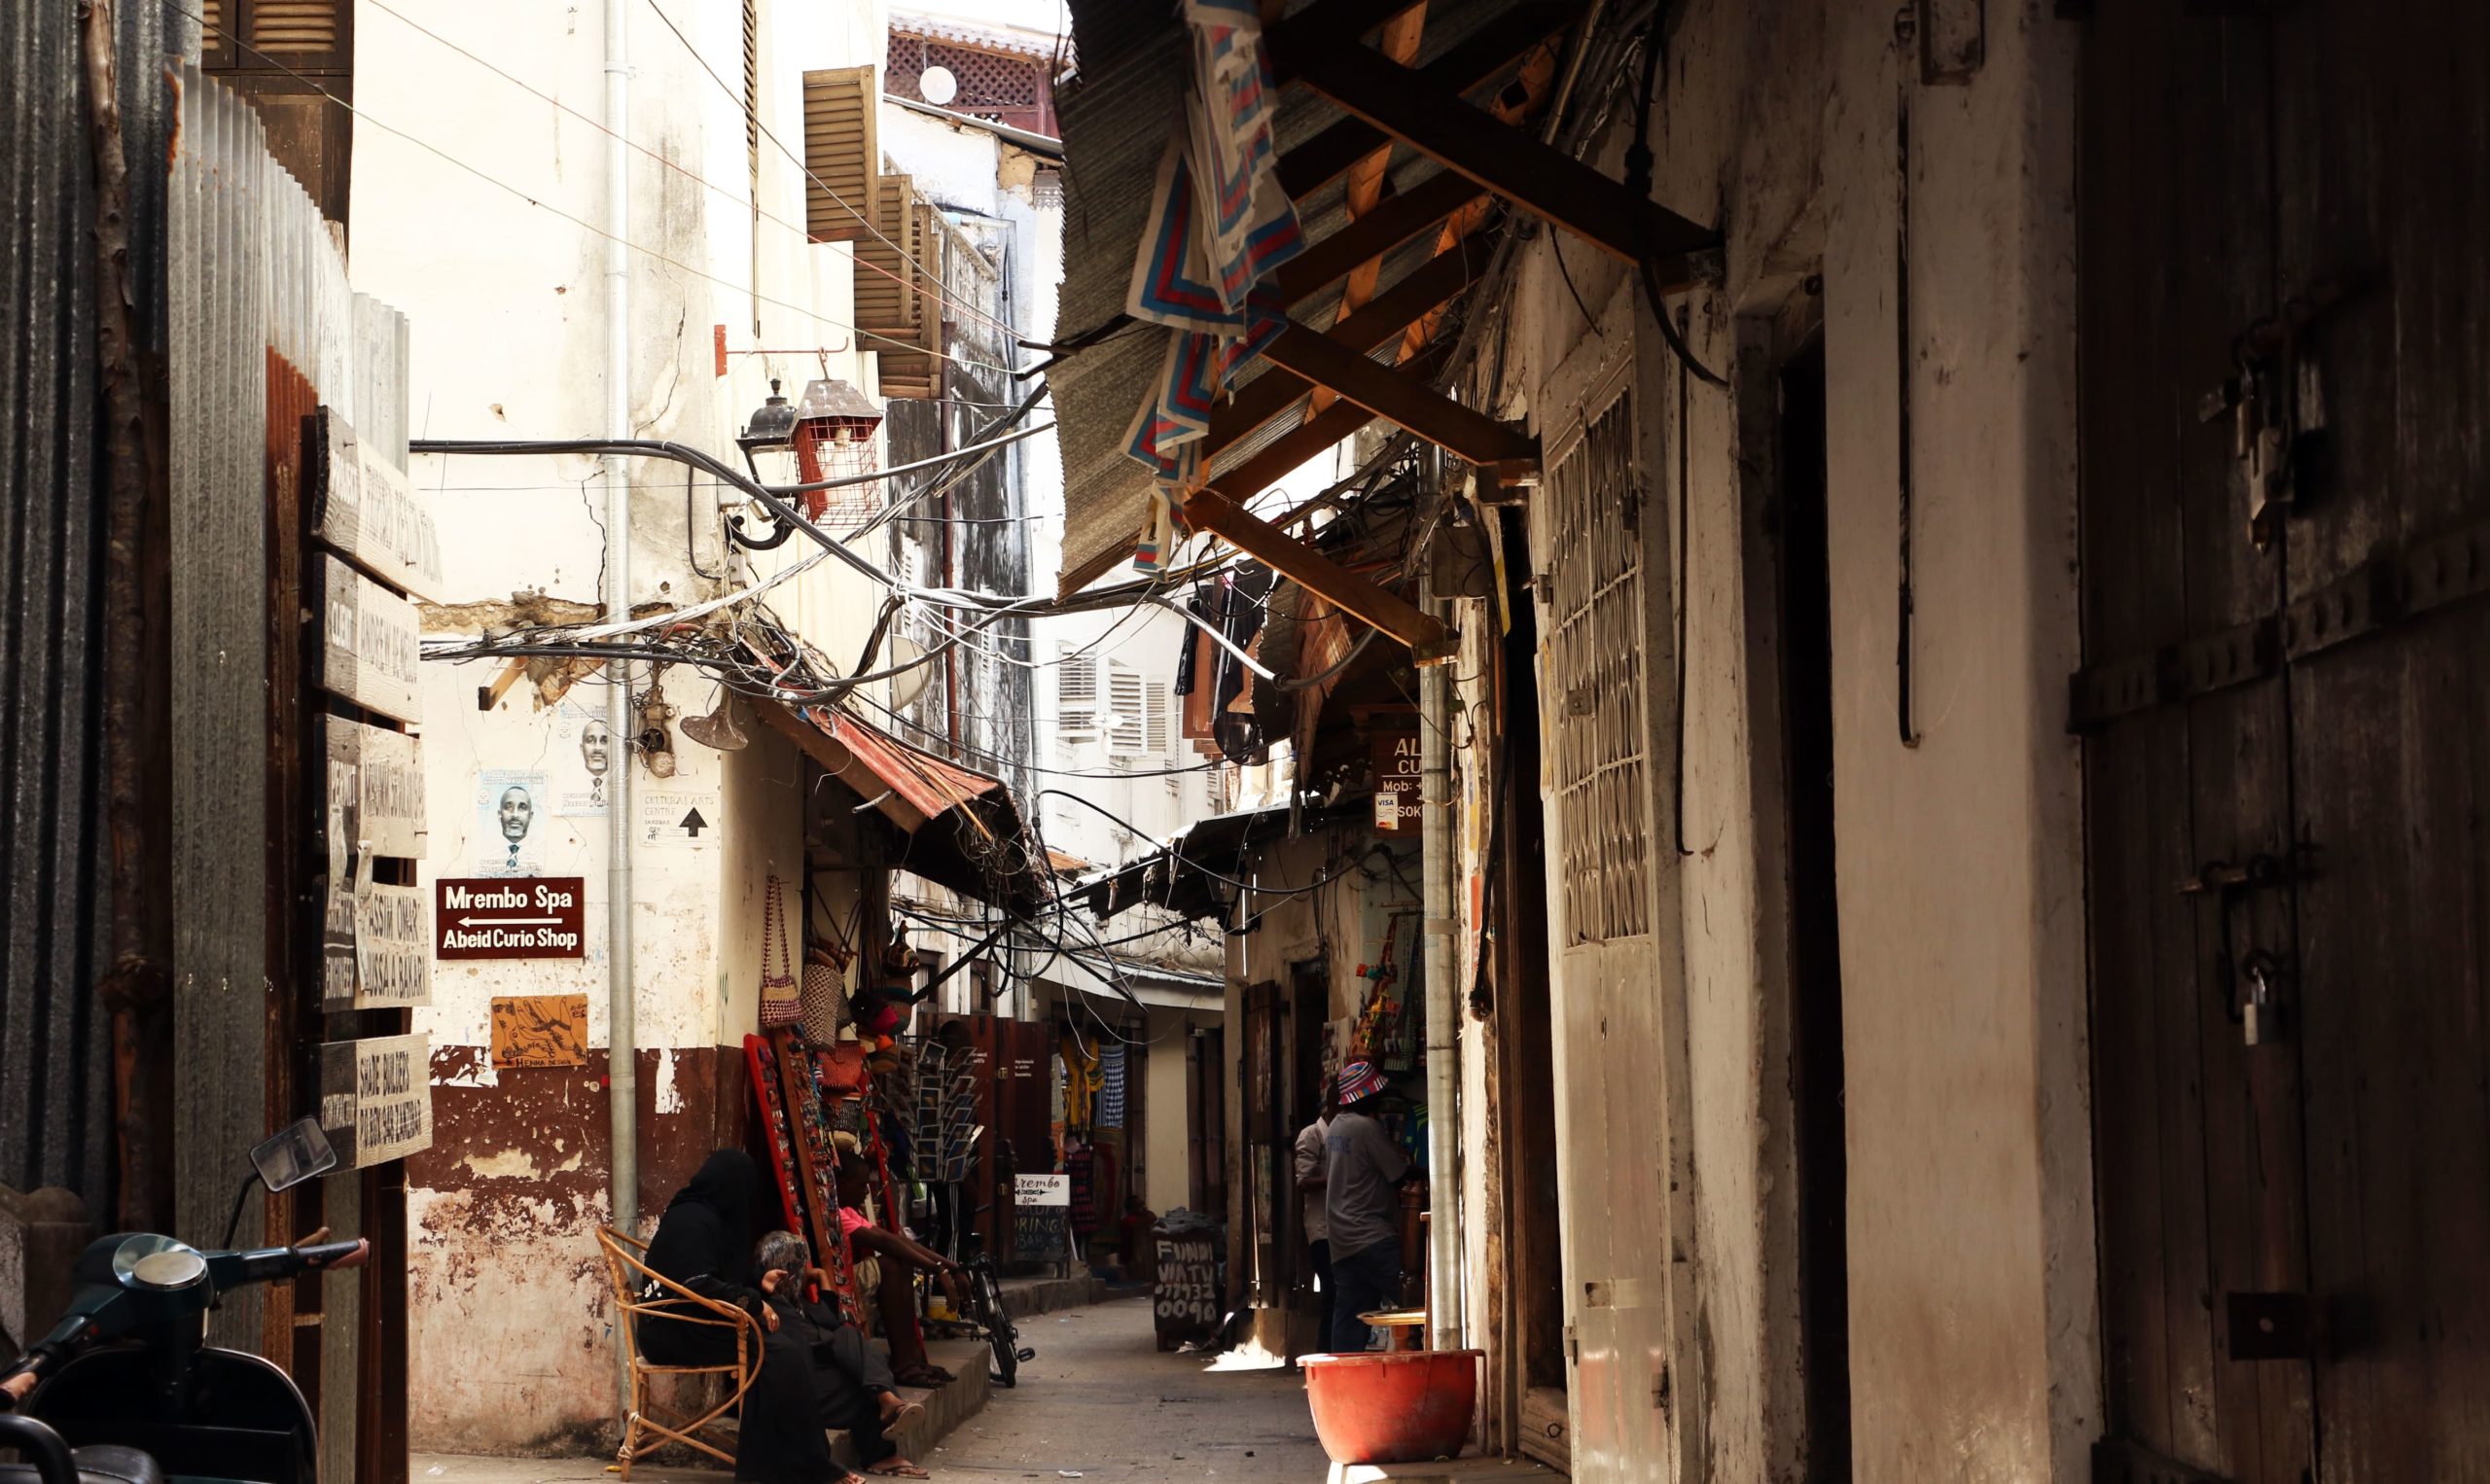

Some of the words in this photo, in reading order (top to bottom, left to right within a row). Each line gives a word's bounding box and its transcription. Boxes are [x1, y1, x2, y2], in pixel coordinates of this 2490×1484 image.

[645, 795, 689, 806] CULTURAL
[691, 795, 715, 806] ARTS
[645, 807, 677, 816] CENTRE
[445, 886, 528, 909] Mrembo
[535, 885, 573, 915] Spa
[443, 930, 492, 949] Abeid
[493, 929, 534, 948] Curio
[537, 928, 578, 951] Shop
[516, 1058, 547, 1068] HENNA
[1156, 1240, 1213, 1263] FUNDI
[1157, 1263, 1215, 1284] VIATU
